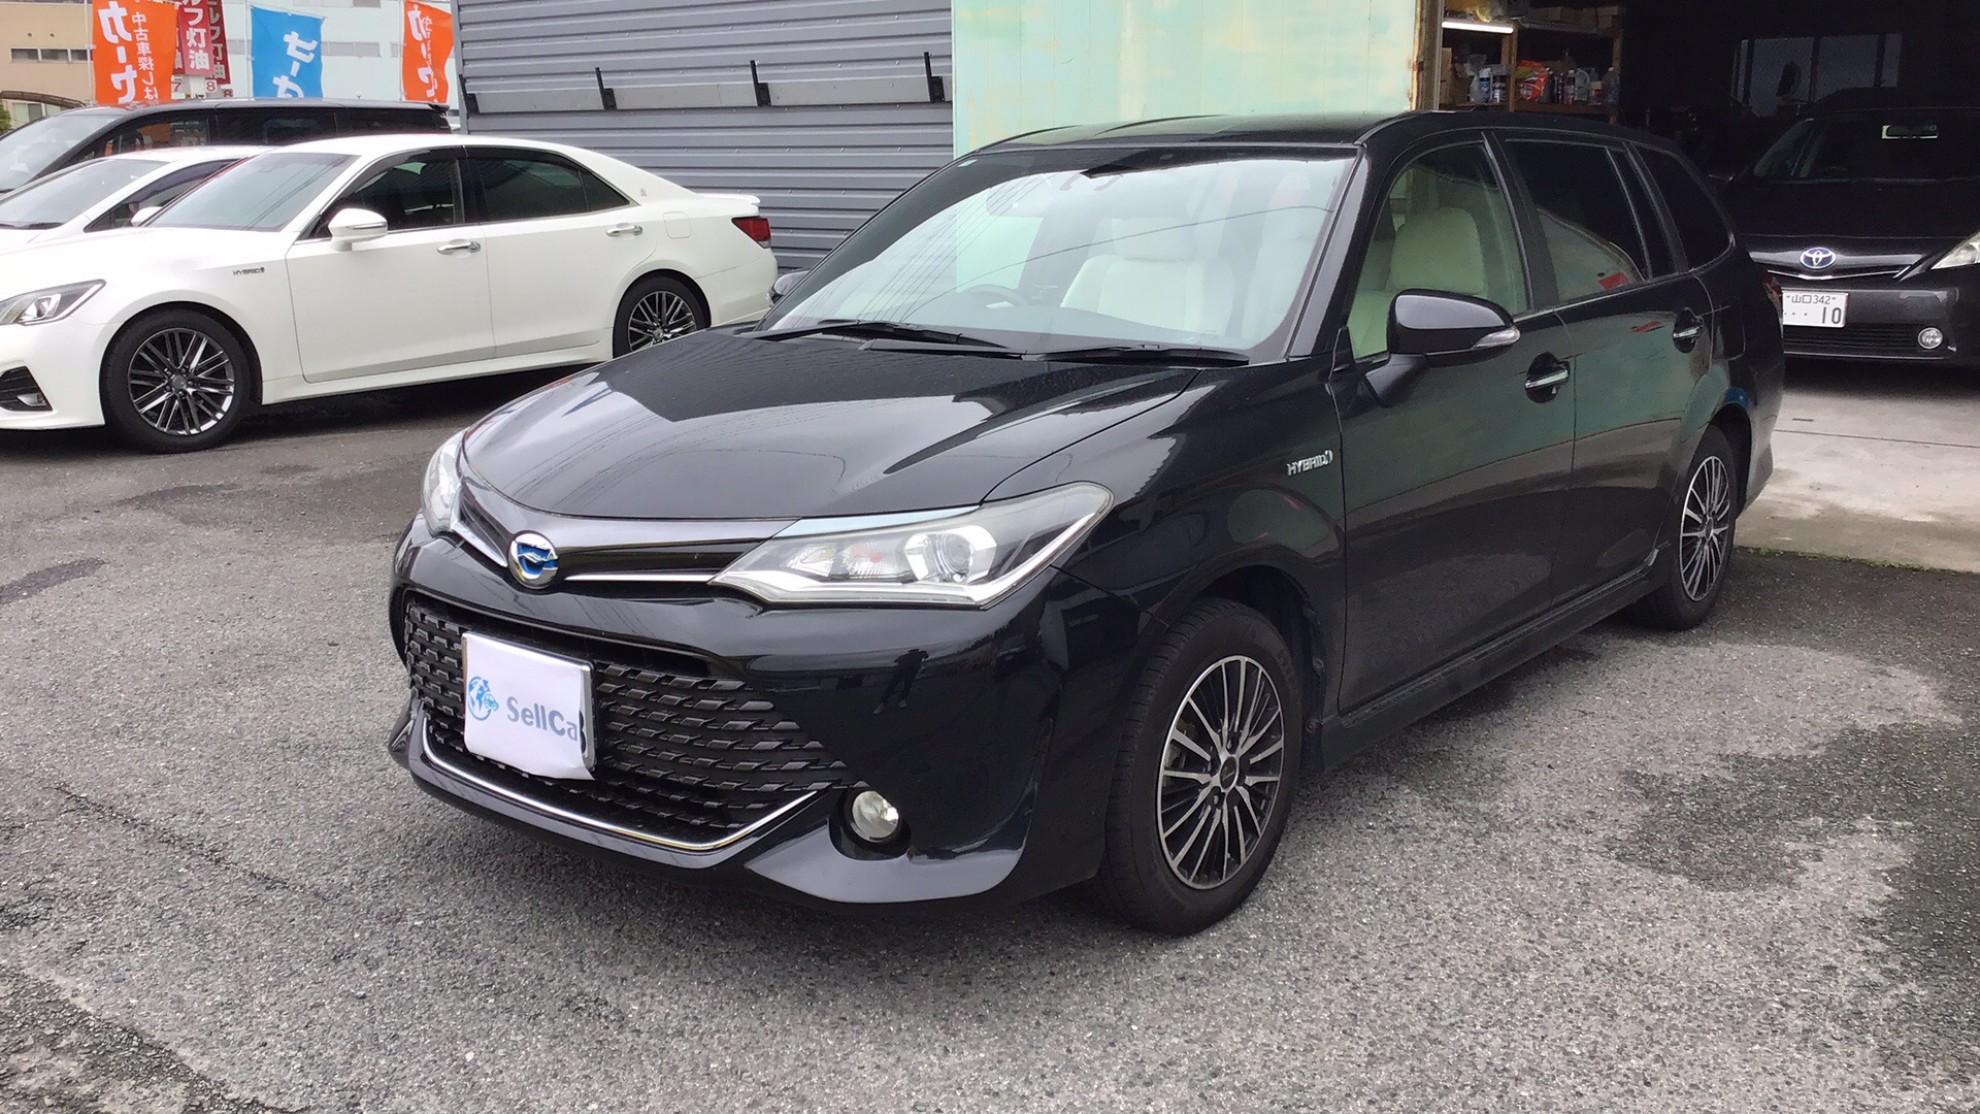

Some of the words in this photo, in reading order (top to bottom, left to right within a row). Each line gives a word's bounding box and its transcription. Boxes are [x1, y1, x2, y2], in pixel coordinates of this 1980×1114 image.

[182, 0, 210, 69] フ灯油
[1287, 454, 1328, 476] HYBRID
